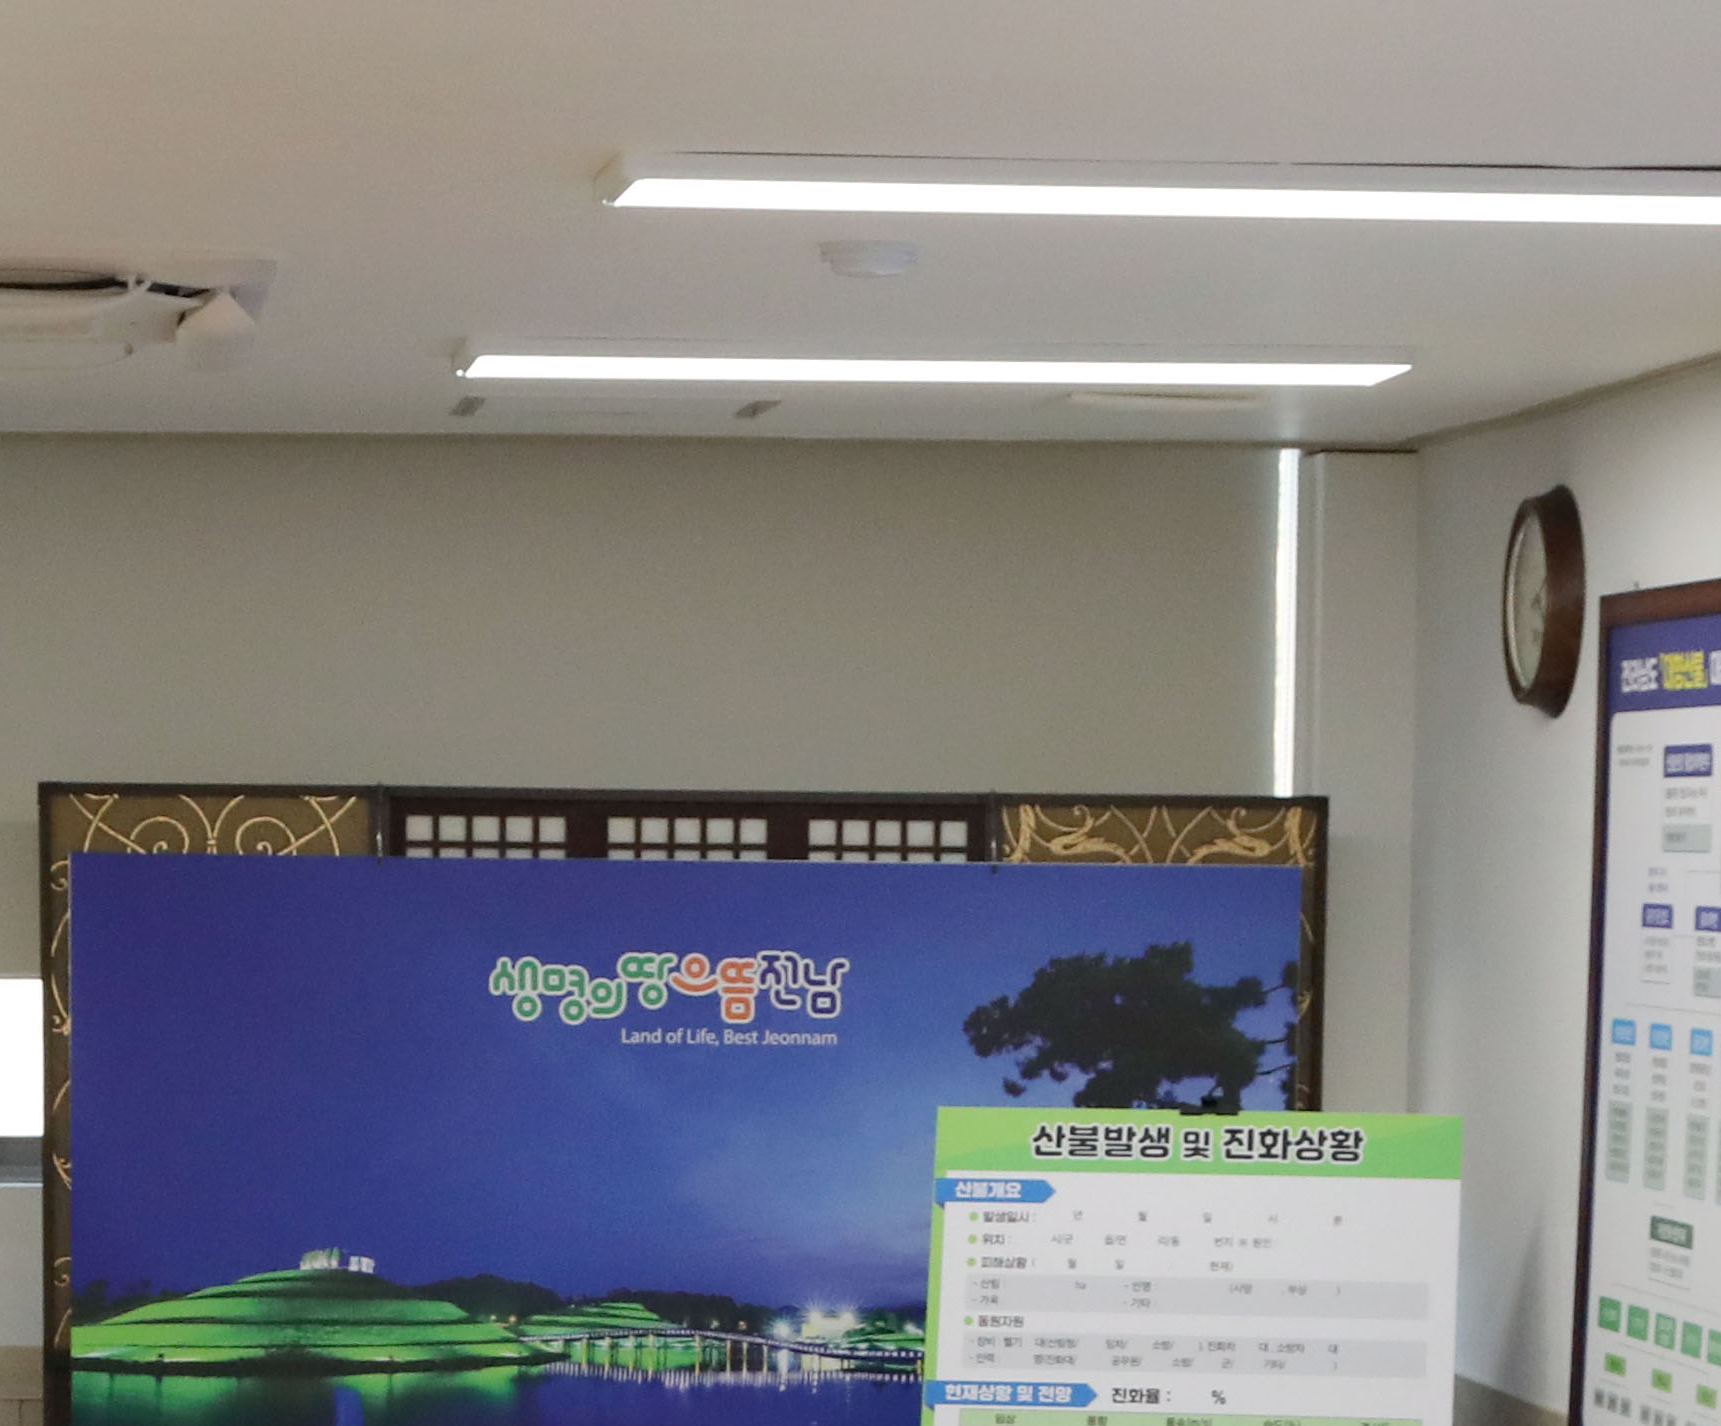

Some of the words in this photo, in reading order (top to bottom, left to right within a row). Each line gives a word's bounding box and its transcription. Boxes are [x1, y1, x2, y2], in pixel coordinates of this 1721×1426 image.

[487, 954, 628, 1026] 생명의
[616, 951, 678, 1010] 땅
[669, 951, 760, 1025] 으뜸
[757, 949, 851, 1019] 전남
[620, 1028, 662, 1045] Land
[665, 1027, 683, 1045] of
[686, 1028, 720, 1047] Life,
[723, 1029, 758, 1046] Best
[762, 1030, 838, 1046] Jeonnam
[1031, 1124, 1171, 1160] 산불발생
[1183, 1129, 1213, 1159] 및
[1222, 1125, 1366, 1163] 진화상황
[954, 1180, 1023, 1200] 산불개요
[982, 1210, 1029, 1223] 발생일시
[980, 1257, 1028, 1270] 피해상황
[977, 1314, 1024, 1328] 동원자원
[944, 1384, 1014, 1401] 현재상황
[1017, 1385, 1034, 1402] 및
[1037, 1385, 1073, 1403] 전망
[1111, 1387, 1160, 1405] 진화율
[1211, 1389, 1227, 1406] %
